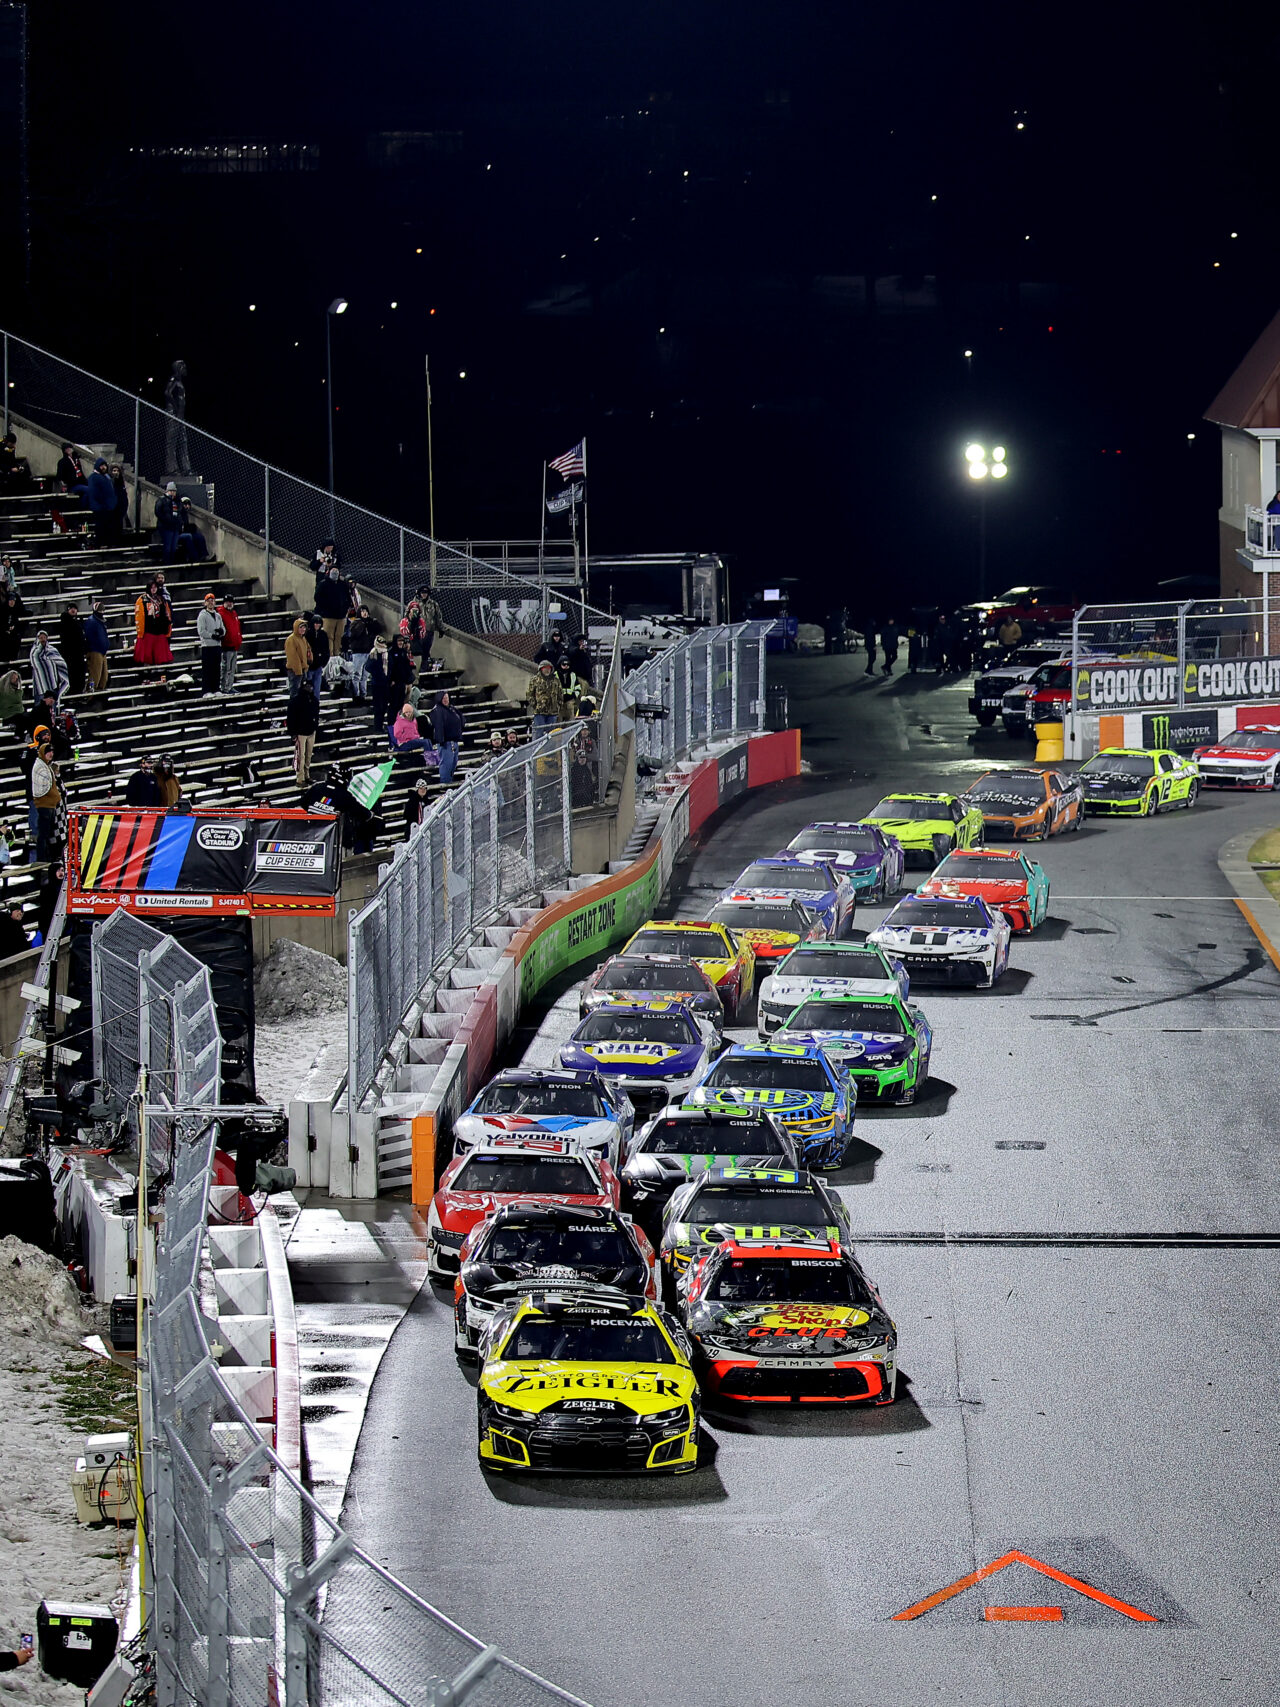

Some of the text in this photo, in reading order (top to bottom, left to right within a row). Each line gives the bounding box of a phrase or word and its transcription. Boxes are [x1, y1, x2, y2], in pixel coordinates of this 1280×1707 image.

[1198, 662, 1247, 697] COOK
[1090, 666, 1177, 705] COOK OUT
[1170, 726, 1210, 738] MONSTER
[1161, 778, 1172, 801] 12
[278, 842, 316, 854] NASCAR
[265, 856, 315, 867] CUP SERIES
[72, 895, 116, 905] SKYJACK
[568, 909, 598, 949] RESTART
[599, 898, 616, 933] ZONE
[598, 1043, 664, 1057] NAPA
[781, 1058, 818, 1066] ZILISCH
[568, 1223, 615, 1233] SUÁREZ
[791, 1260, 843, 1268] BRISCOE
[779, 1309, 823, 1317] Pro
[590, 1318, 655, 1327] HOCEVAR
[778, 1315, 853, 1327] Shops
[747, 1327, 848, 1338] CLUB
[706, 1349, 719, 1359] 19
[506, 1376, 683, 1399] ZEIGLER
[562, 1400, 615, 1410] ZEIGLER
[502, 1426, 514, 1435] 77
